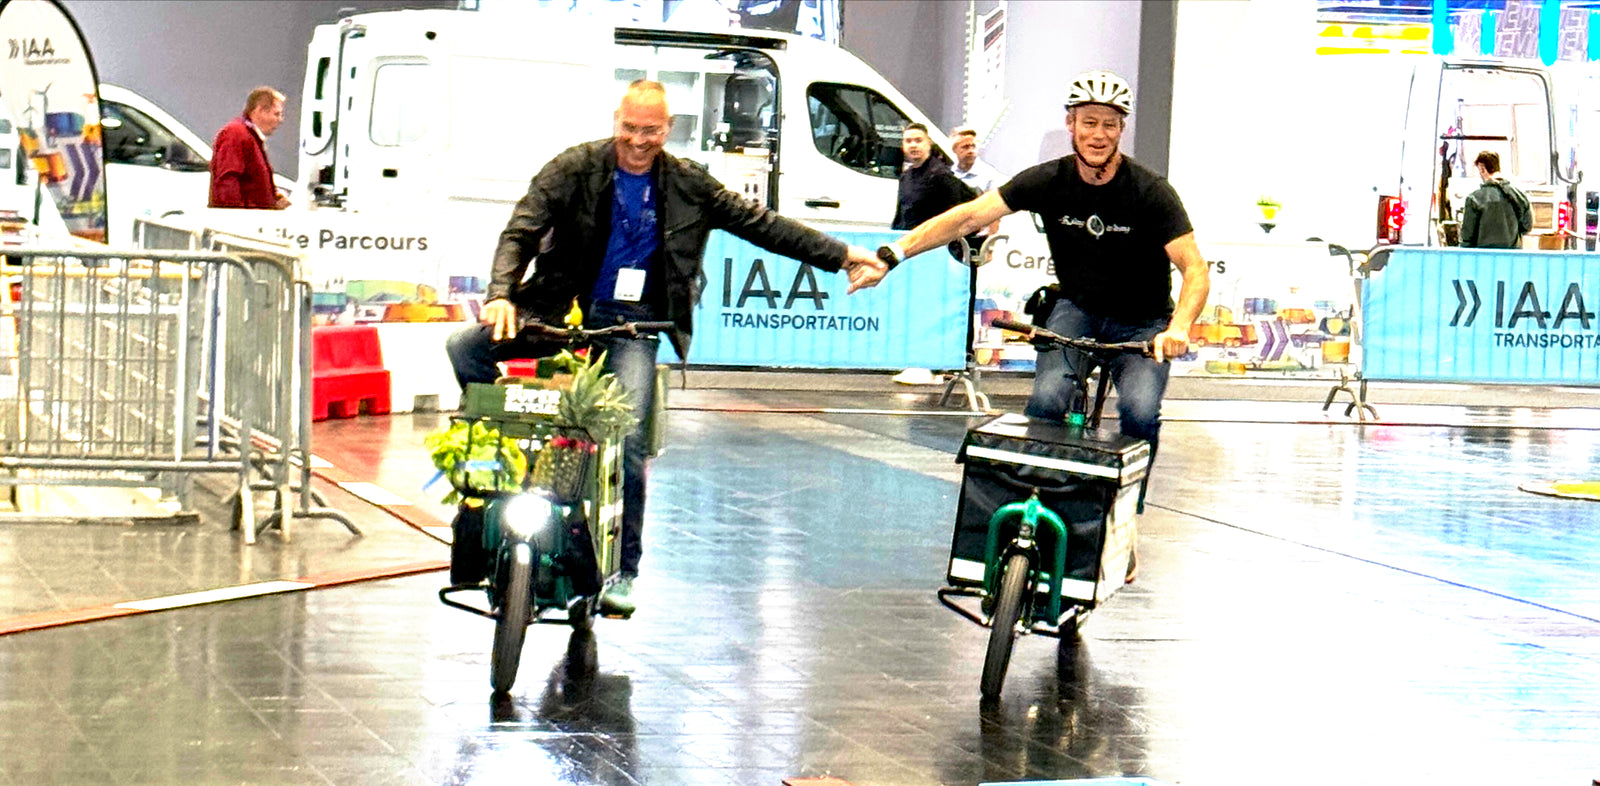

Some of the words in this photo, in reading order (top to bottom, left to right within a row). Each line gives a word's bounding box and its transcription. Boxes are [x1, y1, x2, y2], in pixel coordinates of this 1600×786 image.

[22, 38, 55, 57] IAA
[319, 229, 428, 251] Parcours
[722, 257, 829, 311] IAA
[1495, 280, 1596, 330] IAA
[721, 312, 880, 332] TRANSPORTATION
